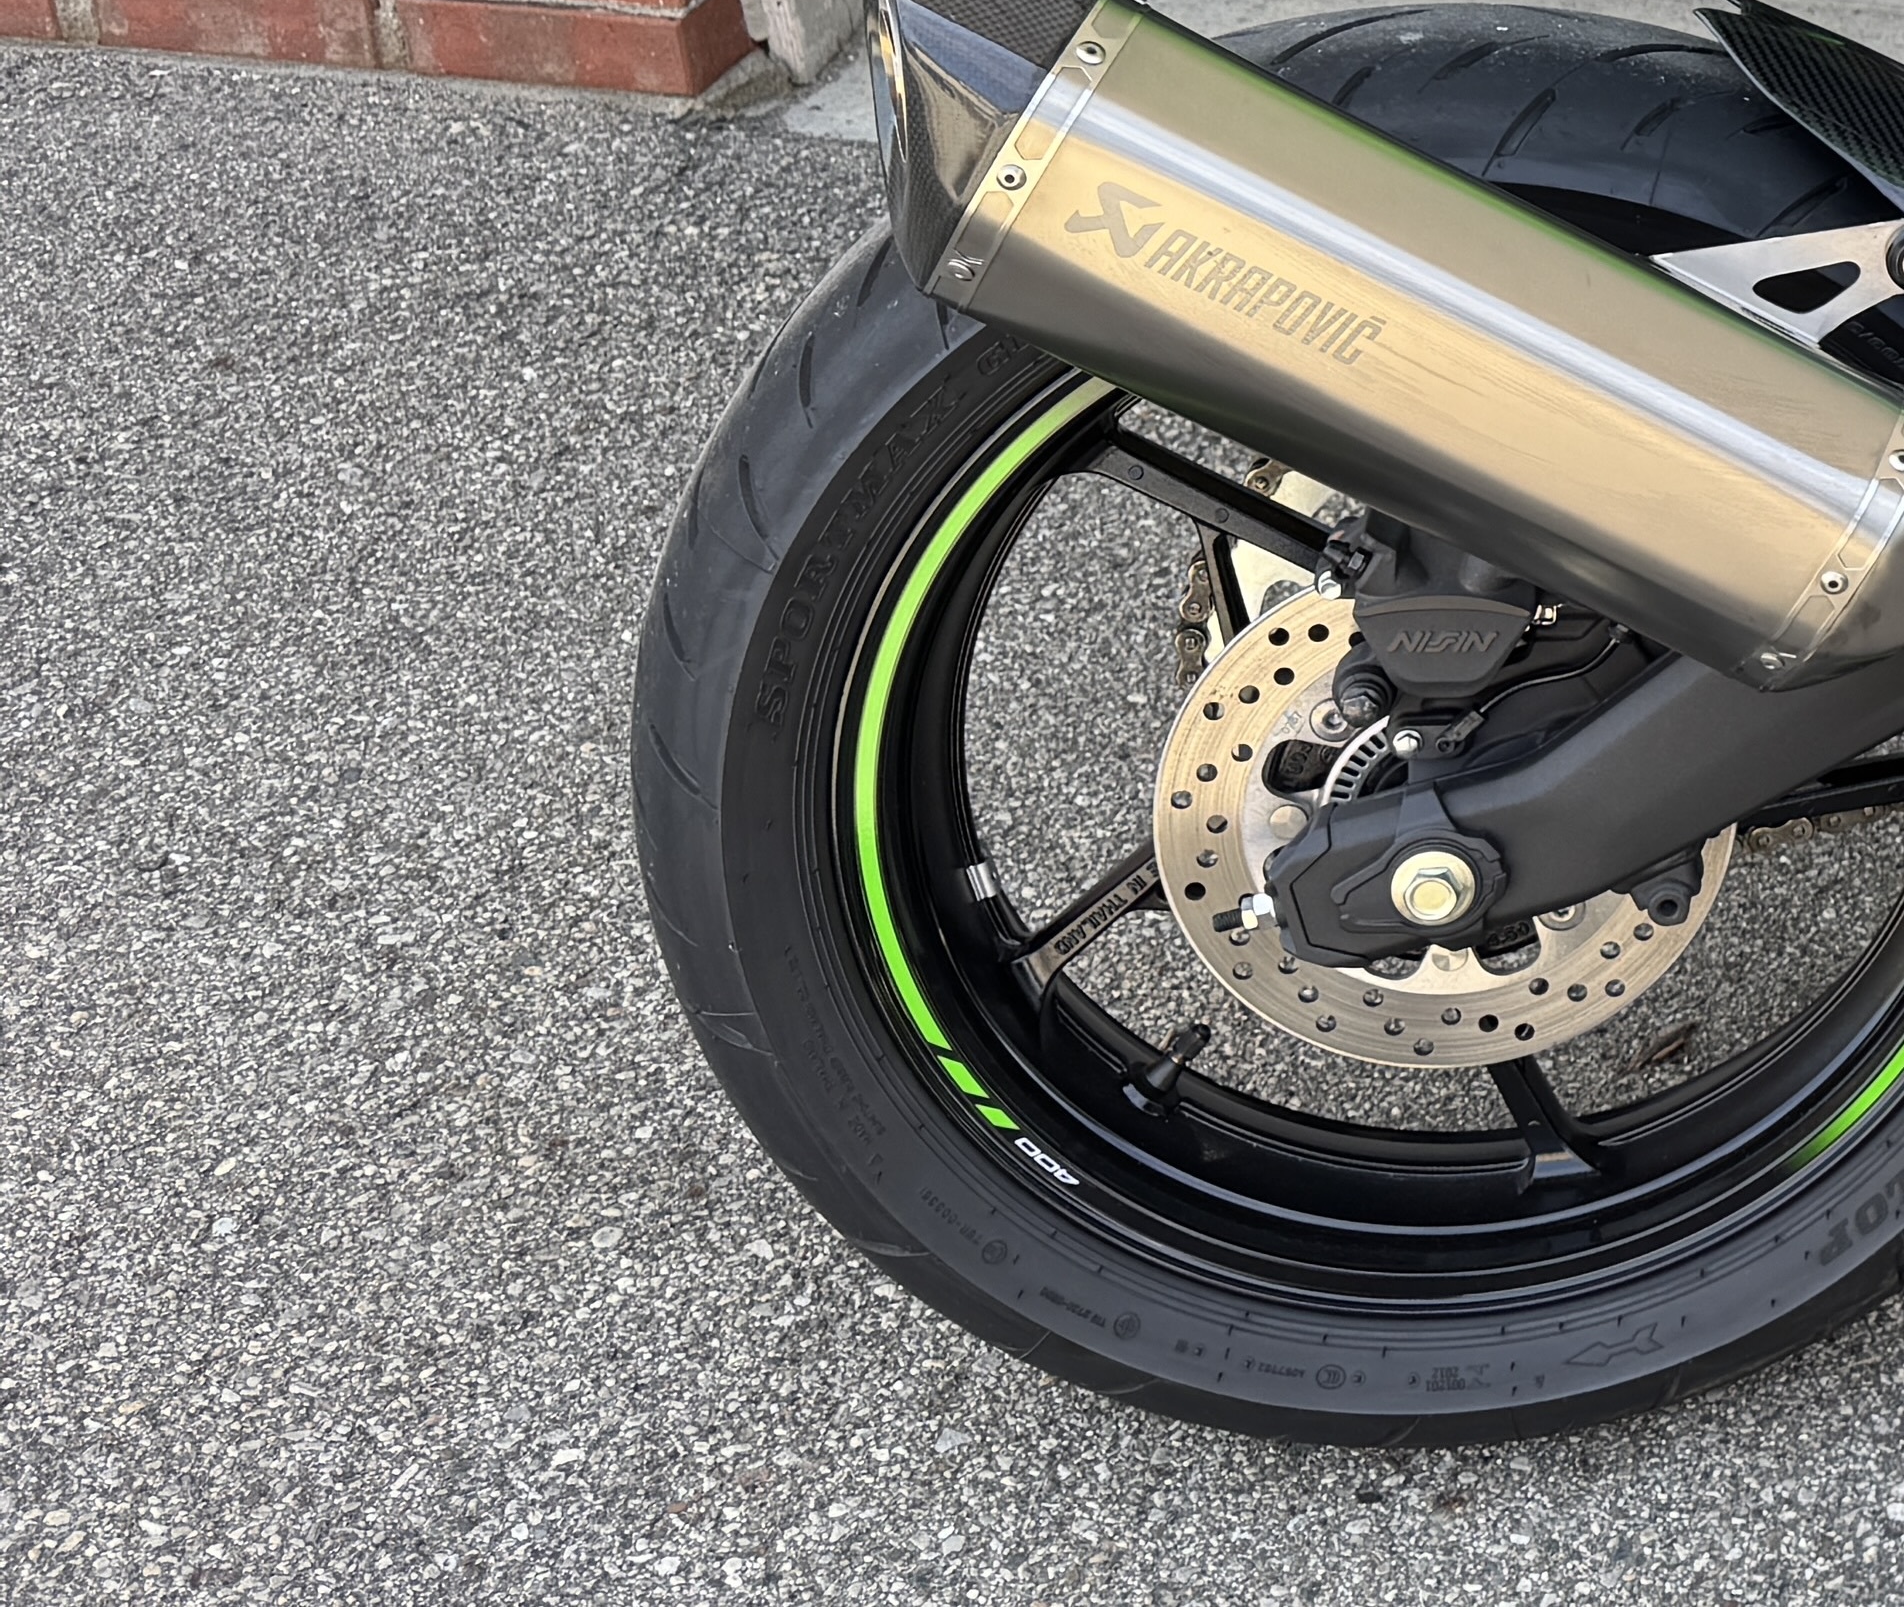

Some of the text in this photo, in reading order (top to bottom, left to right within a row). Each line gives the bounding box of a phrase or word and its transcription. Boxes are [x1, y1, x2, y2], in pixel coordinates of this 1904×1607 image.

[756, 374, 959, 727] SPORTMAX
[1055, 892, 1128, 957] THAILAND
[1015, 1137, 1080, 1188] 400
